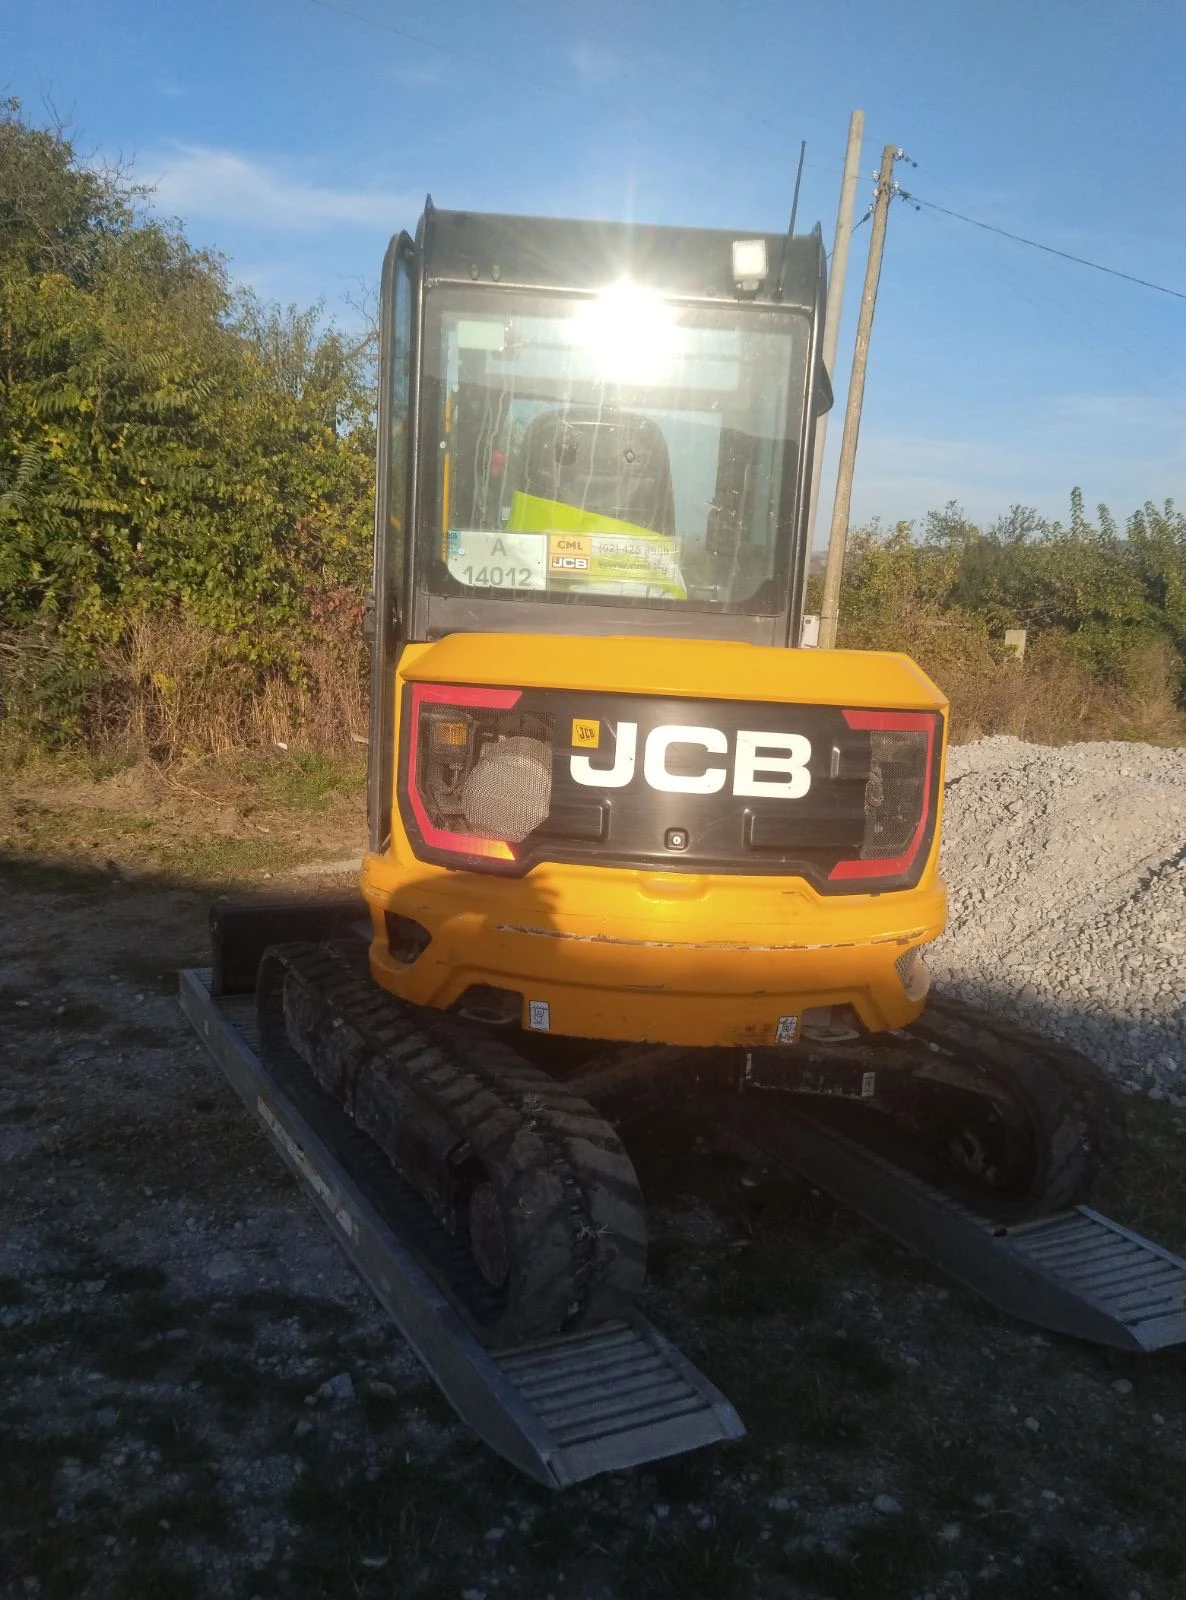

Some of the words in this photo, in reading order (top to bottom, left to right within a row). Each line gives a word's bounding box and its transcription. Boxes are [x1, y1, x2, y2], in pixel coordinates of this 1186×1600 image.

[491, 538, 507, 557] A
[557, 540, 584, 551] CML
[552, 557, 588, 569] JCB
[463, 565, 532, 587] 14012
[579, 726, 595, 740] JCB
[570, 721, 812, 799] JCB
